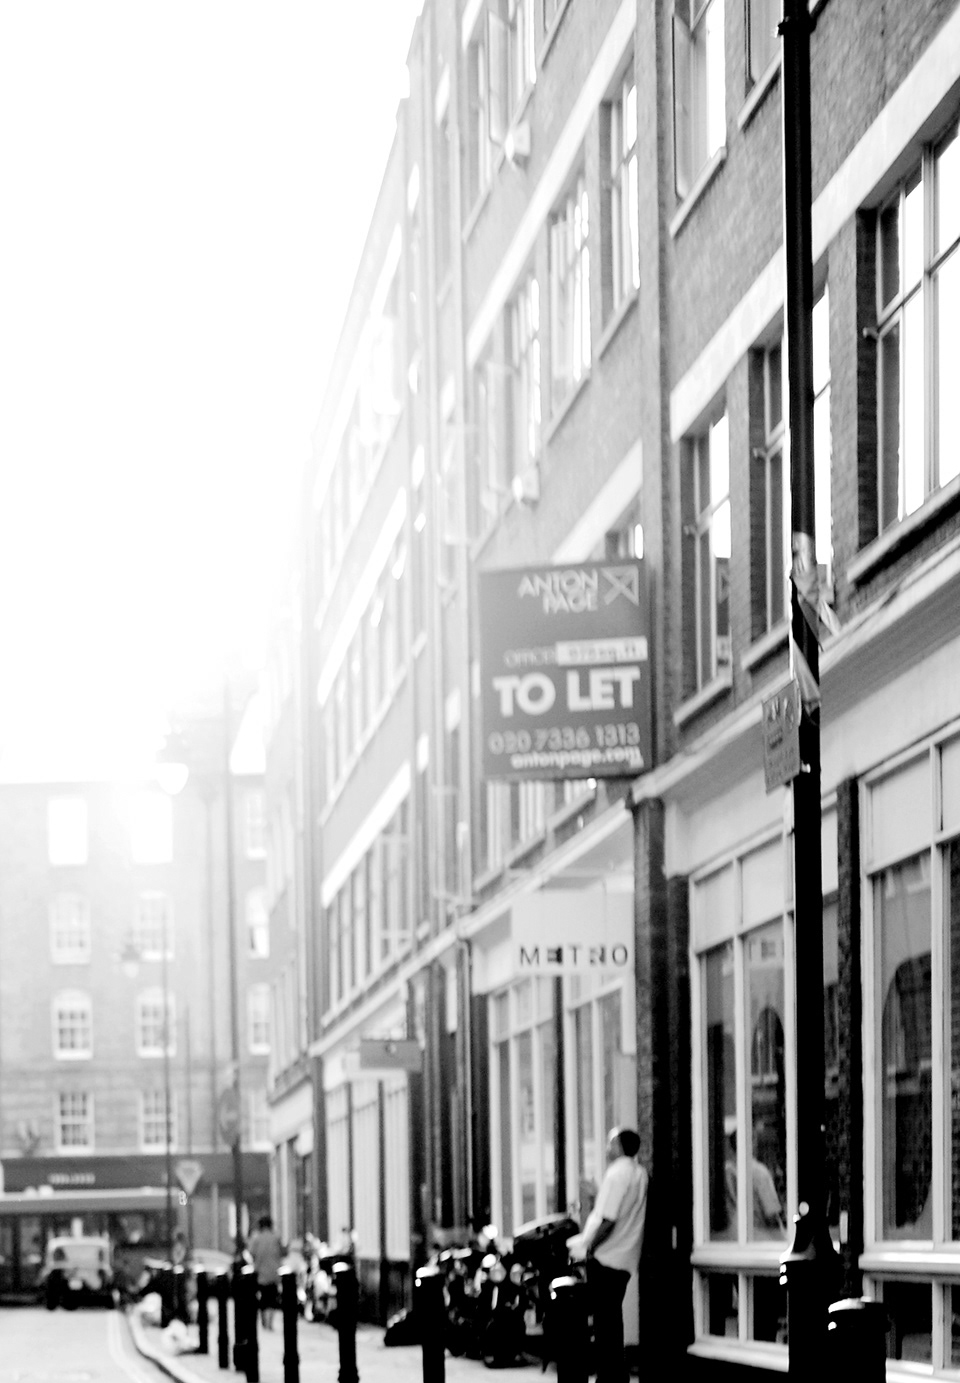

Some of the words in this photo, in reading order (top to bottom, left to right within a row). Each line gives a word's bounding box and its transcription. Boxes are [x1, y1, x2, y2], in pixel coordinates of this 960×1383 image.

[517, 568, 598, 599] ANTON
[543, 590, 598, 615] PAGE
[492, 671, 556, 718] TO
[566, 666, 641, 712] LET
[488, 730, 532, 755] 020
[534, 725, 590, 751] 7336
[594, 721, 640, 748] 1313
[519, 943, 629, 968] METRO
